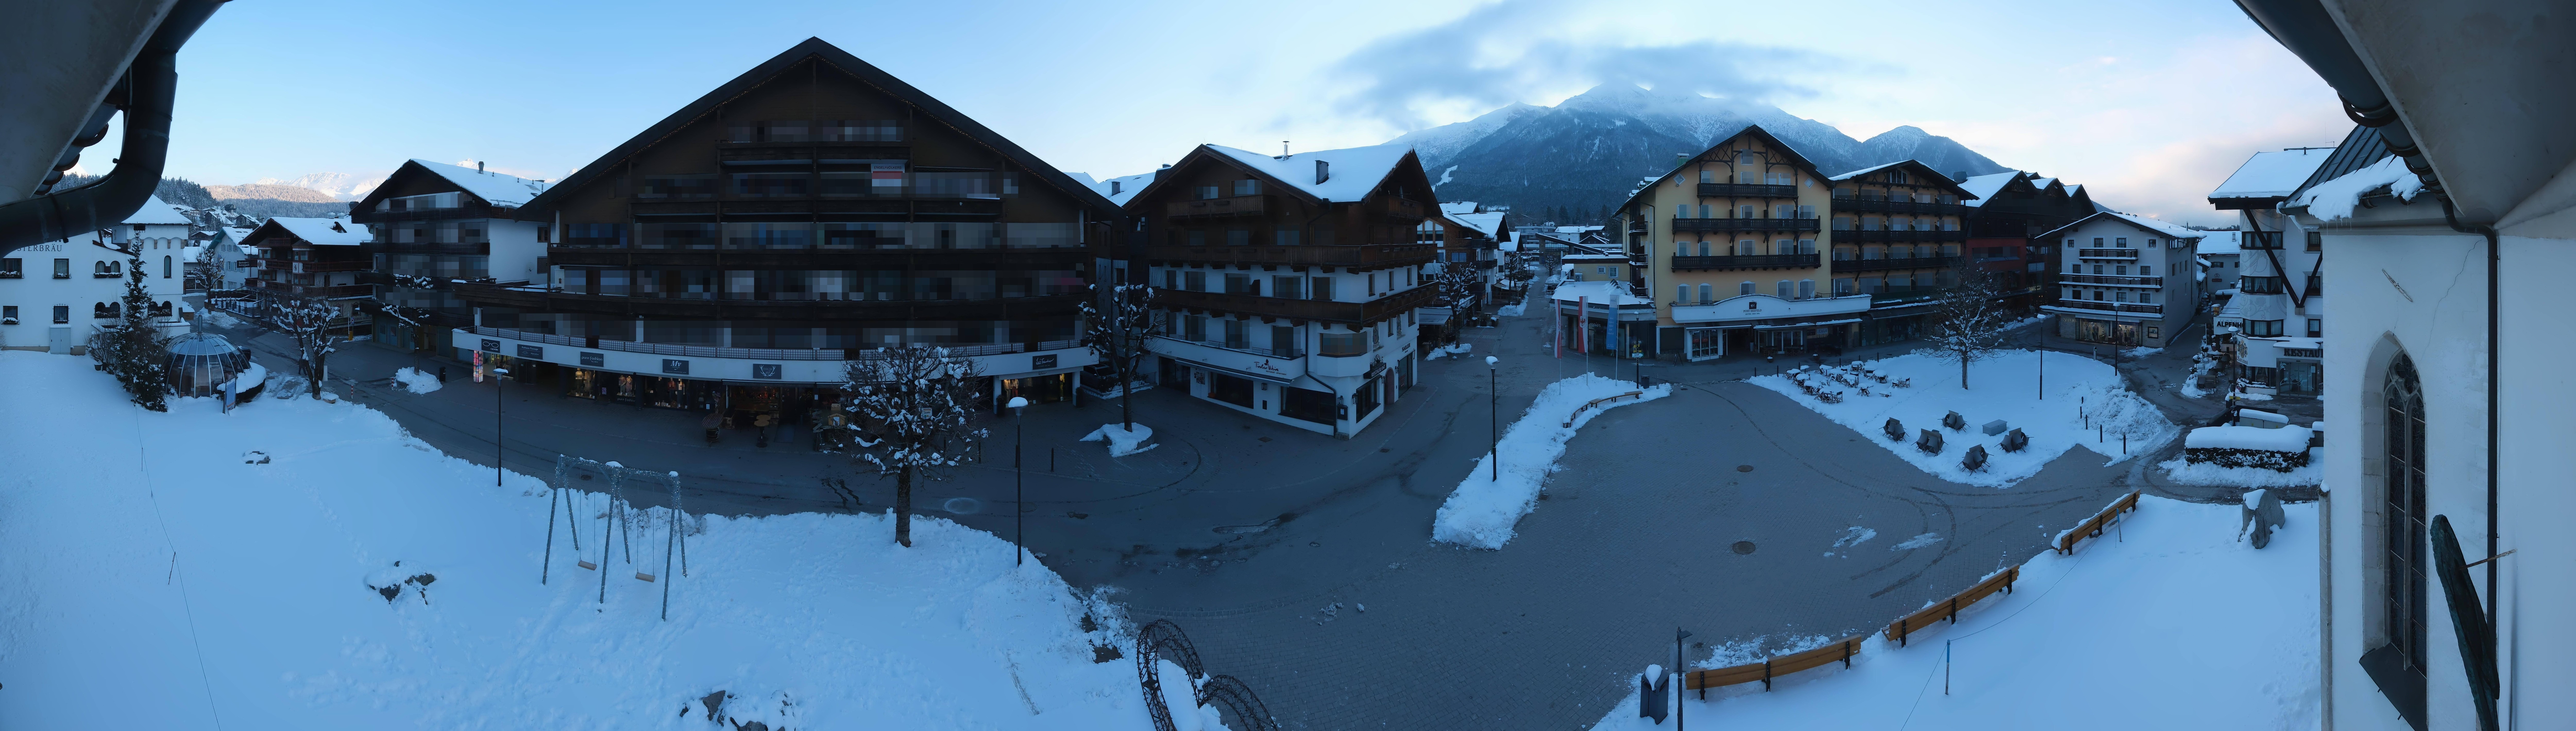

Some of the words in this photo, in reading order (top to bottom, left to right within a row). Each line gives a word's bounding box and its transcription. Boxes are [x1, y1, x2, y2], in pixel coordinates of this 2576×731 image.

[1402, 343, 1410, 352] SAILER
[670, 361, 681, 370] My
[1371, 364, 1385, 377] RESTAURANT
